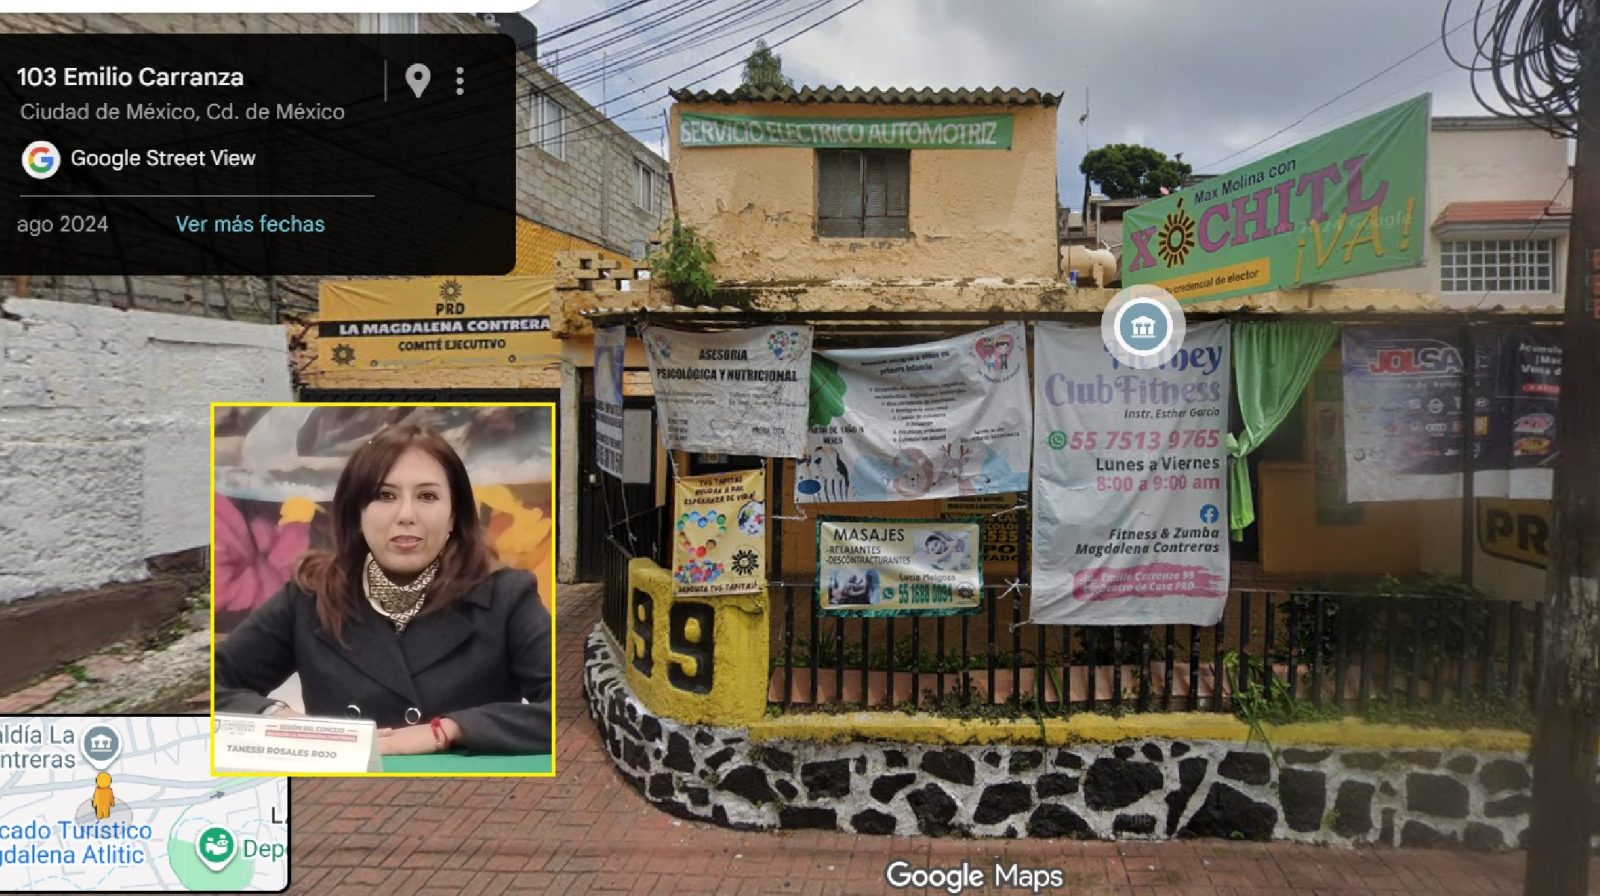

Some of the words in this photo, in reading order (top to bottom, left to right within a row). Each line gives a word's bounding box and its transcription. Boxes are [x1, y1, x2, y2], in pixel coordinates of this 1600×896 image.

[680, 120, 764, 143] SERVICIO
[769, 121, 864, 144] ELECTRICO
[868, 121, 997, 145] AUTOMOTRIZ
[1194, 188, 1218, 205] Max
[1222, 172, 1264, 195] Molina
[1268, 159, 1296, 179] con
[1173, 278, 1213, 292] credencial
[1215, 275, 1226, 285] de
[1227, 269, 1259, 283] elector
[436, 303, 465, 315] PRD
[339, 323, 359, 336] LA
[363, 321, 462, 334] MAGDALENA
[467, 317, 550, 331] CONTRERA
[398, 338, 442, 351] COMITÉ
[445, 339, 506, 351] EJECUTIVO
[1367, 347, 1464, 375] JOLSA
[657, 367, 717, 380] PSICOLÓGICA
[719, 370, 726, 380] Y
[727, 369, 797, 382] NUTRICIONAL
[880, 364, 904, 375] primera
[1045, 373, 1114, 406] Club
[1115, 375, 1221, 406] Fitness
[1125, 408, 1153, 419] Instr.
[1155, 408, 1187, 418] Esther
[1069, 431, 1098, 450] 55
[1105, 430, 1161, 450] 7513
[1168, 429, 1220, 449] 9765
[1096, 457, 1144, 472] Lunes
[1150, 461, 1158, 471] a
[1161, 456, 1220, 471] Viernes
[1096, 475, 1133, 492] 8:00
[1138, 479, 1148, 491] a
[1153, 475, 1187, 491] 9:00
[1193, 477, 1220, 490] am
[684, 496, 725, 505] ESPERANZA
[833, 528, 905, 542] MASAJES
[1108, 528, 1157, 540] Fitness
[1160, 529, 1170, 539] &
[1173, 527, 1219, 539] Zumba
[1075, 543, 1149, 557] Magdalena
[1153, 541, 1220, 554] Contreras
[1183, 570, 1195, 579] 99
[899, 584, 908, 604] 55
[227, 745, 265, 754] TANESSI
[266, 747, 309, 758] ROSALES
[311, 751, 337, 759] ROJO
